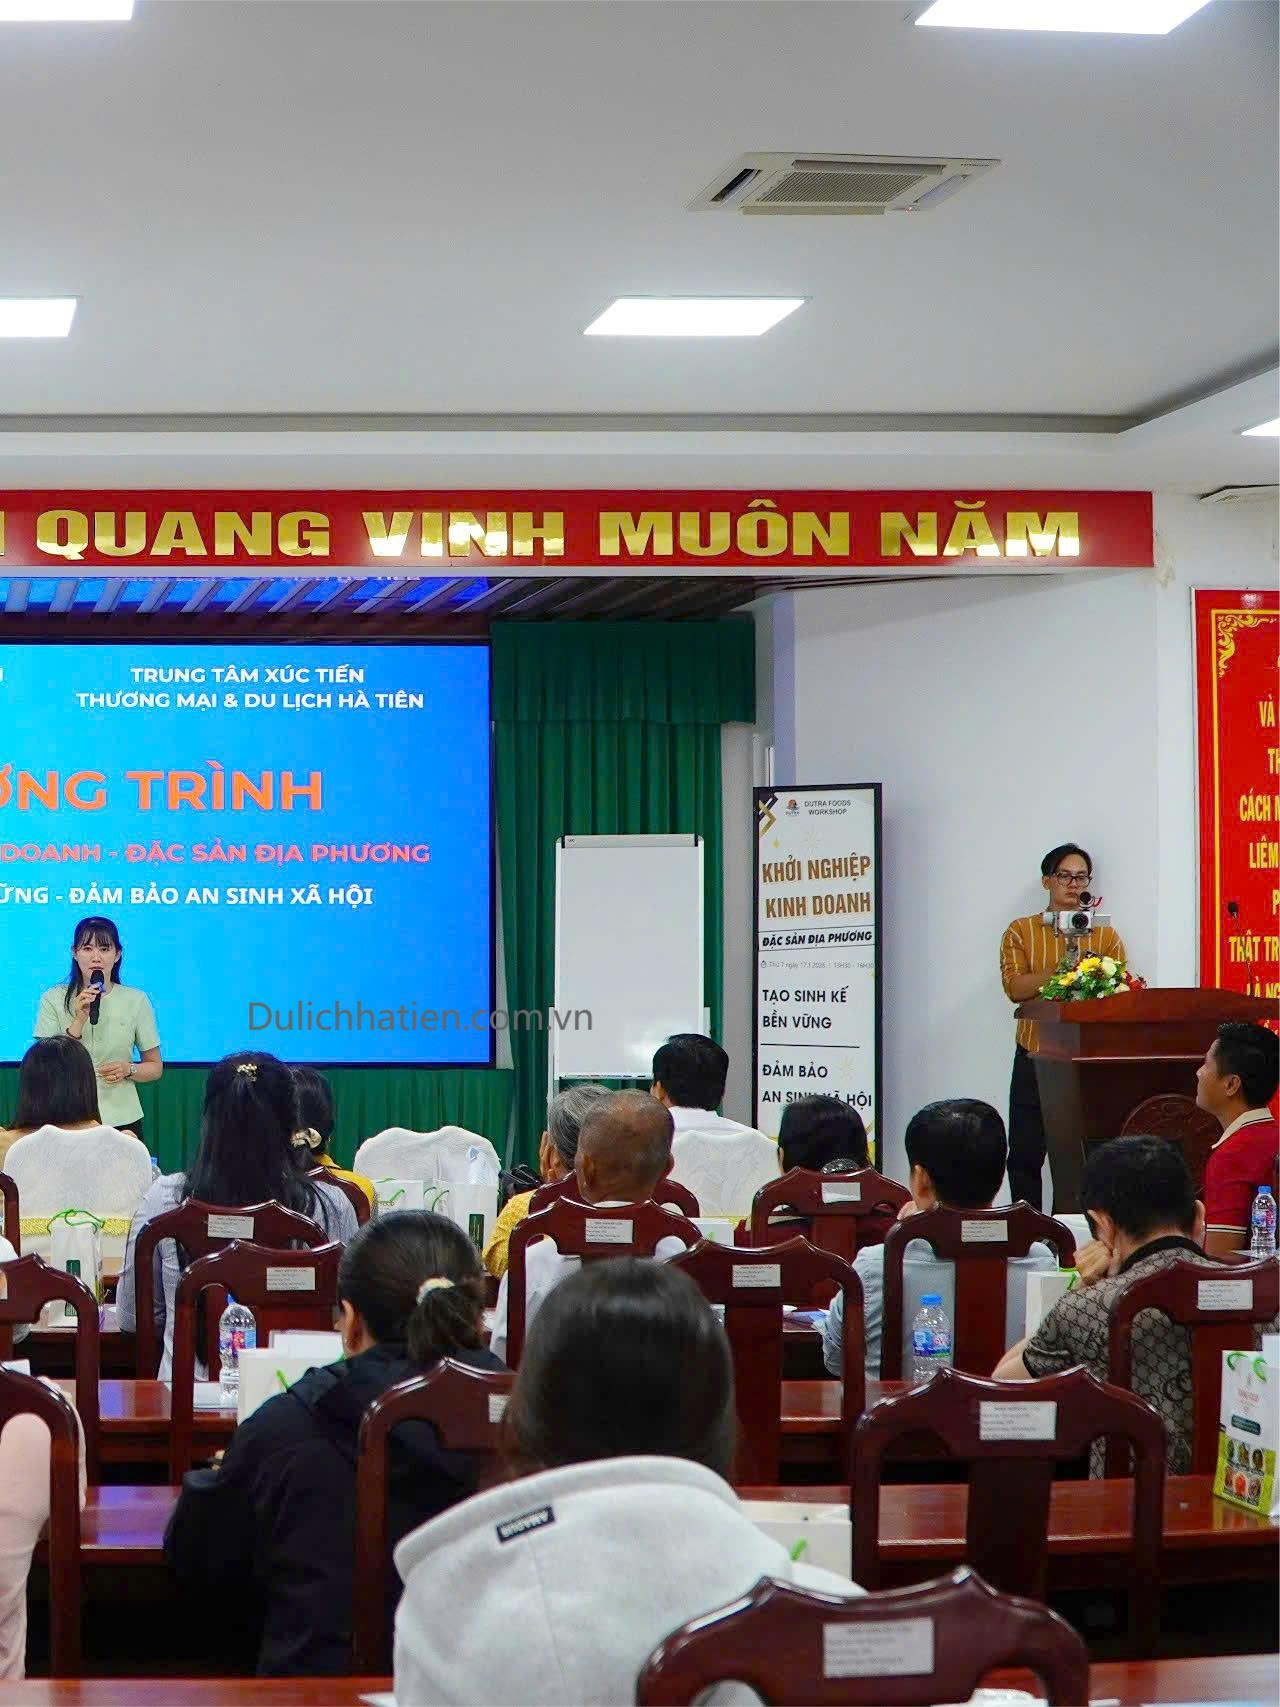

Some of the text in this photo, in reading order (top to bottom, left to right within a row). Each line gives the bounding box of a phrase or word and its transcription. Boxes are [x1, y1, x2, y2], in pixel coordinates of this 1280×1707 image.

[36, 509, 330, 561] QUANG
[361, 511, 564, 557] VINH
[599, 499, 850, 557] MUÔN
[880, 499, 1080, 557] NĂM
[131, 662, 365, 683] TRUNG TÂM XÚC TIẾN
[76, 689, 425, 712] THƯƠNG MẠI & DU LỊCH HÀ TIÊN
[1259, 694, 1276, 727] VÀ
[125, 760, 322, 811] TRÌNH
[808, 808, 848, 816] WORKSHOP
[829, 799, 852, 807] FOODS
[1240, 786, 1271, 821] CÁCH
[0, 844, 101, 862] DOANH
[126, 840, 186, 868] ĐẶC
[191, 838, 247, 862] SẢN
[255, 844, 304, 867] ĐỊA
[311, 841, 431, 863] PHƯƠNG
[1249, 835, 1279, 868] LIÊM
[762, 852, 871, 883] KHỞI NGHIỆP
[69, 882, 123, 904] ĐẢM
[131, 882, 179, 904] BẢO
[185, 887, 219, 904] AN
[227, 887, 283, 904] SINH
[290, 883, 322, 904] XÃ
[329, 884, 373, 909] HỘI
[766, 892, 871, 918] KINH DOANH
[762, 931, 872, 949] ĐẶC SẢN ĐỊA PHƯƠNG
[762, 985, 849, 1005] TẠO SINH KẾ
[762, 1010, 832, 1029] BỀN VỮNG
[762, 1060, 828, 1078] ĐẢM BẢO
[762, 1091, 781, 1103] AN
[847, 1091, 872, 1110] HỘI
